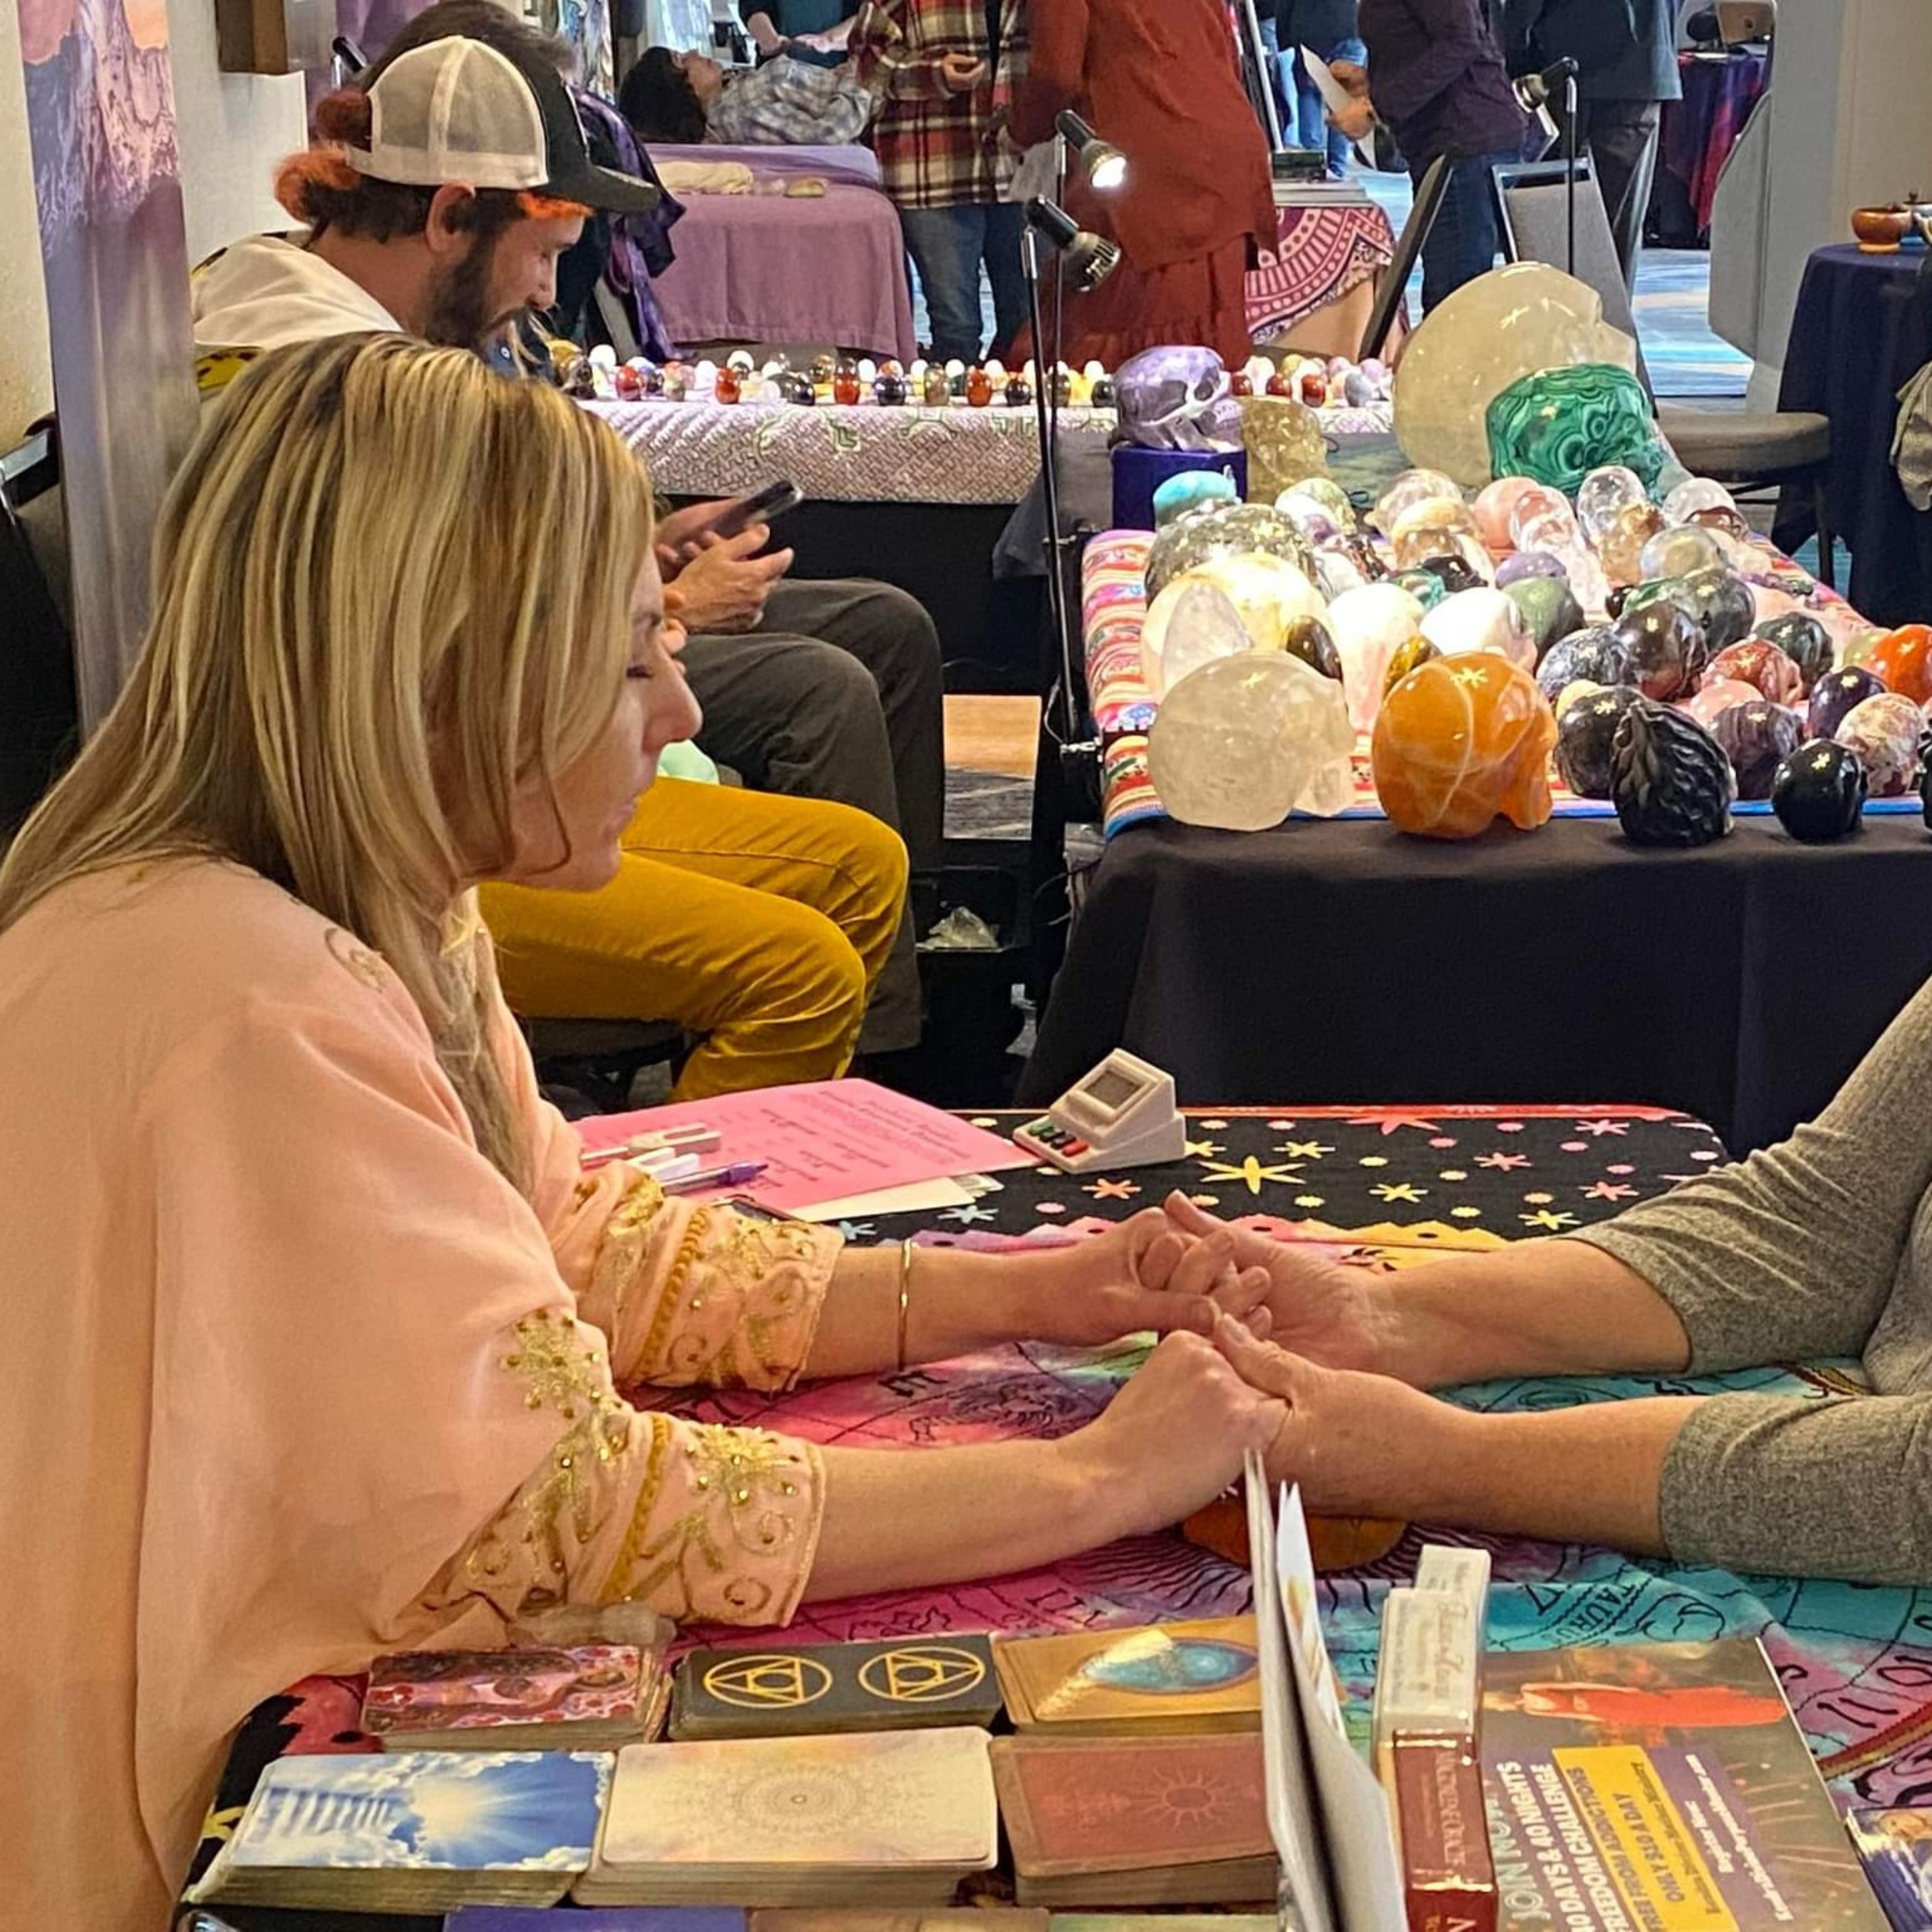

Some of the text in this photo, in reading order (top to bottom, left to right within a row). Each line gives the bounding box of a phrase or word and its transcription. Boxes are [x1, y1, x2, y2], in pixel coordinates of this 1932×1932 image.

[1496, 1761, 1544, 1824] NIGHTS
[1530, 1764, 1594, 1855] CHALLENGE
[1566, 1767, 1624, 1852] ADDICTIONS
[1613, 1792, 1643, 1821] DAY
[1526, 1825, 1554, 1847] 40
[1536, 1849, 1563, 1862] &
[1635, 1835, 1664, 1860] $10
[1497, 1863, 1552, 1920] JOIN
[1543, 1864, 1586, 1911] DAYS
[1611, 1855, 1649, 1896] FROM
[1651, 1865, 1686, 1902] ONLY
